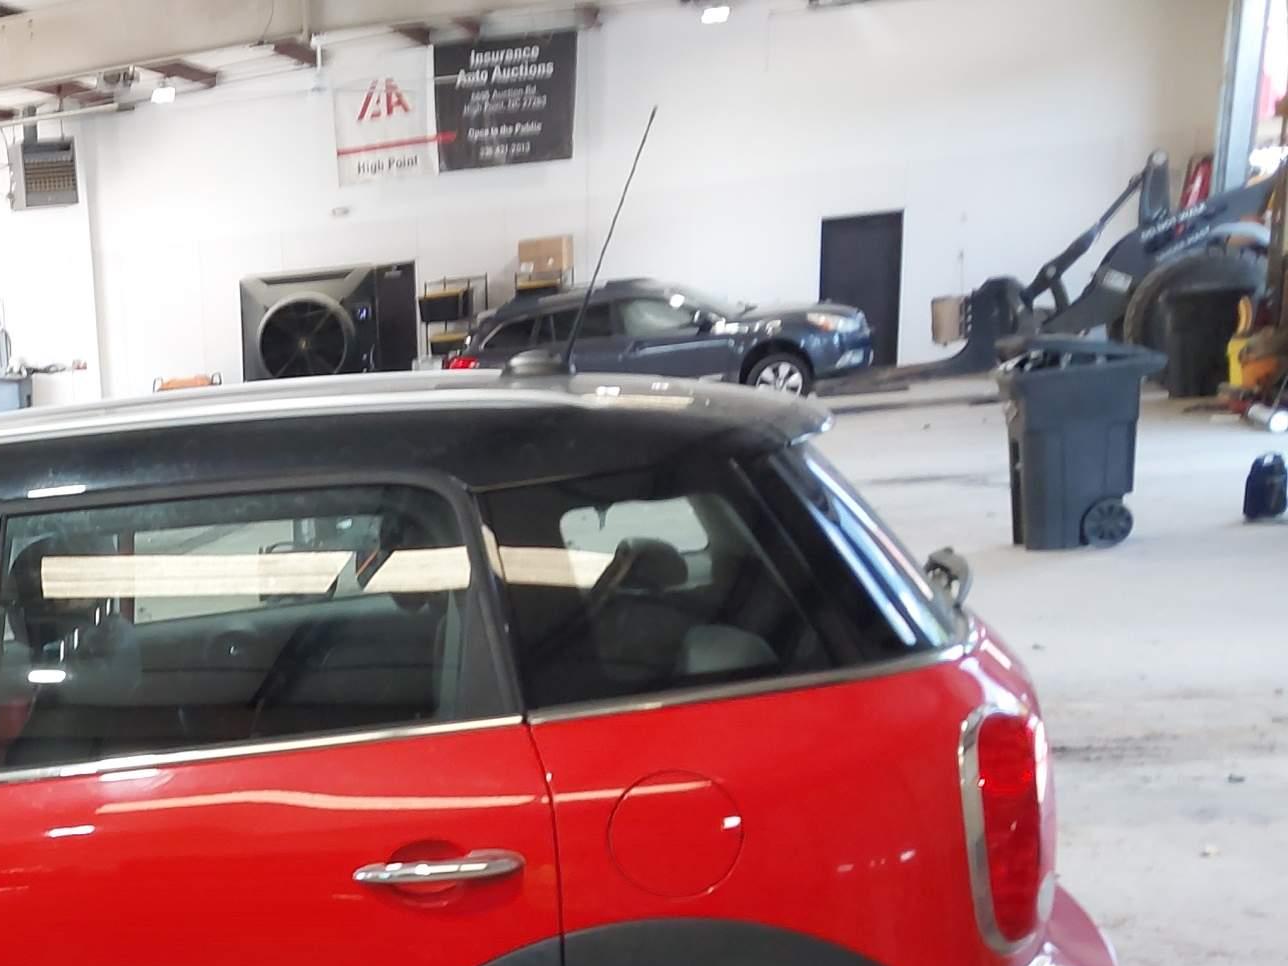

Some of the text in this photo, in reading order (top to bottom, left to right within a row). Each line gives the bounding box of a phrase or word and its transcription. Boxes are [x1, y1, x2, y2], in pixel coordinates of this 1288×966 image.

[470, 45, 540, 68] Insurance
[456, 60, 554, 88] Auto Auctions
[357, 154, 418, 175] High Point
